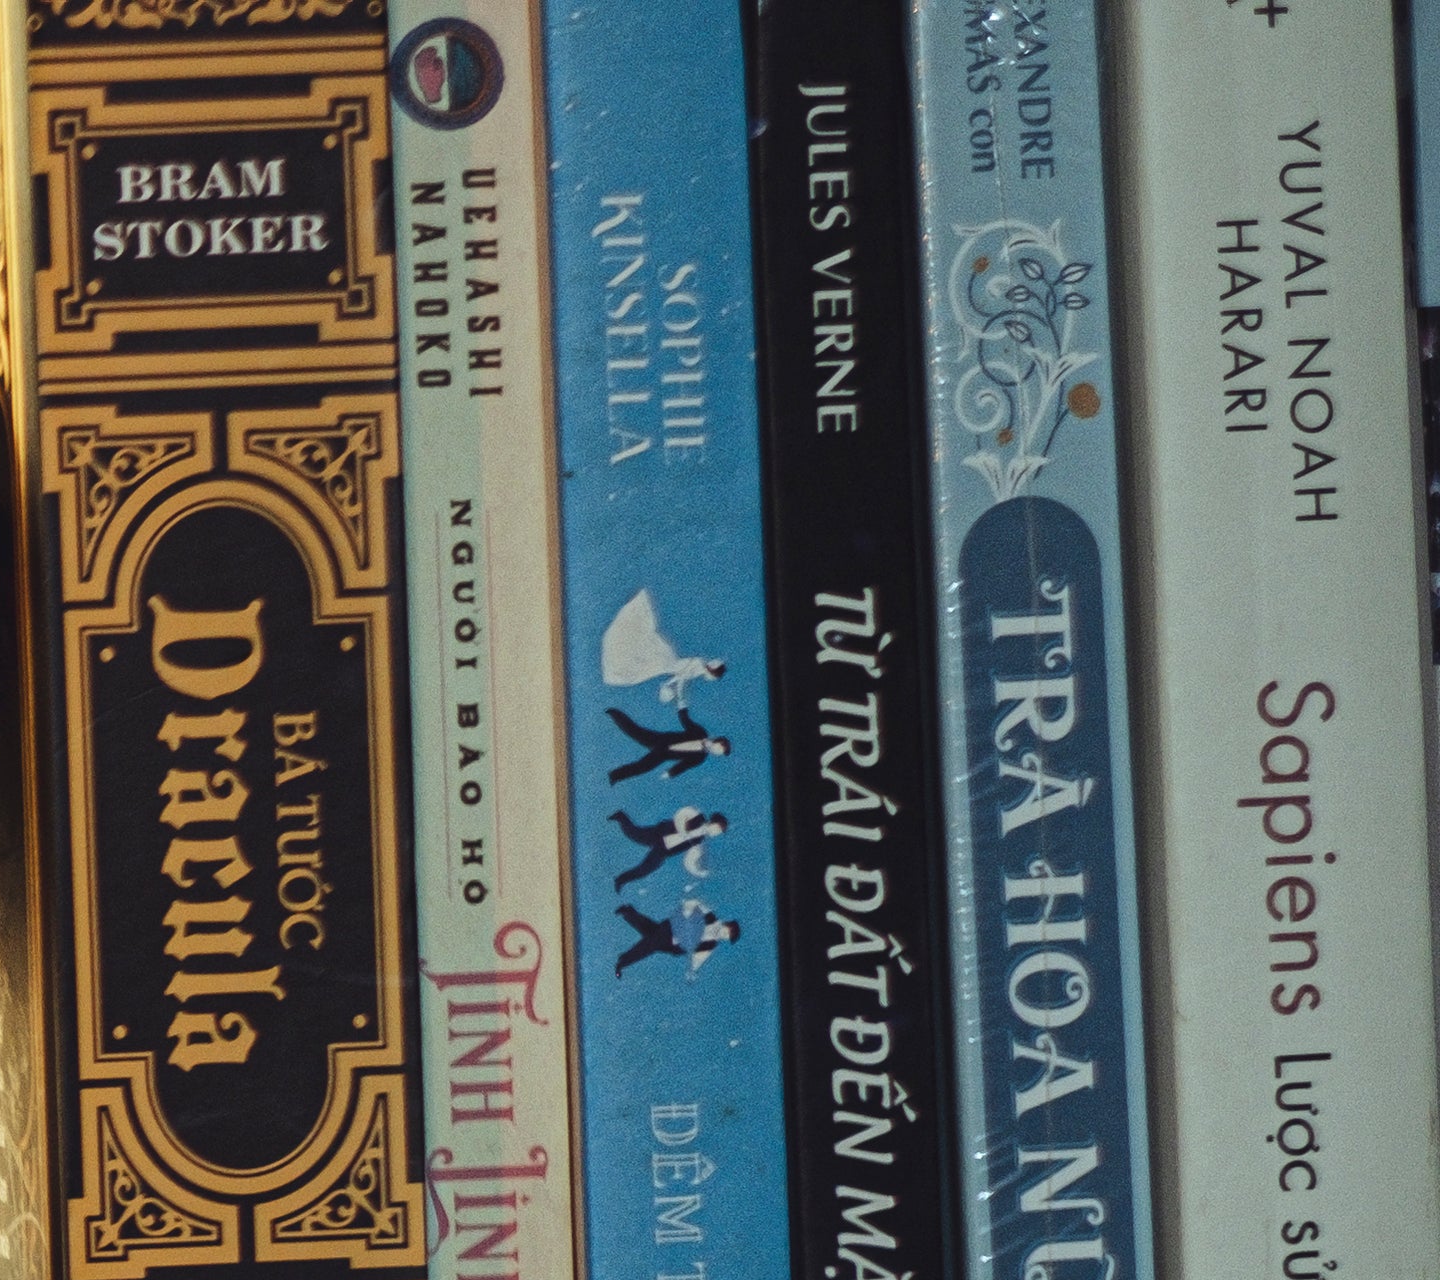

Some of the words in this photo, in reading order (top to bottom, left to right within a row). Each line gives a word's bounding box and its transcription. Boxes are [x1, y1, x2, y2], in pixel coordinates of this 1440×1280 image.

[115, 158, 286, 207] BRAM
[799, 85, 850, 232] JULES
[970, 106, 998, 173] con
[1275, 120, 1328, 310] YUVAL
[93, 213, 329, 262] STOKER
[411, 181, 451, 390] NAHOKO
[463, 167, 504, 398] UEHASHI
[591, 193, 652, 466] KINSELLA
[1216, 219, 1268, 434] HARARI
[660, 263, 706, 467] SOPHIE
[811, 249, 857, 434] VERNE
[1287, 337, 1340, 523] NOAH
[814, 588, 896, 678] TỪ
[990, 578, 1096, 836] TRÀ
[148, 595, 286, 1072] Dracula
[274, 712, 328, 785] BÁ
[819, 694, 896, 843] TRÁI
[275, 794, 334, 950] TƯỚC
[825, 863, 914, 1007] ĐẤT
[1236, 680, 1337, 1016] Sapiens
[1005, 861, 1096, 1118] HOA
[829, 1016, 918, 1165] ĐẾN
[1264, 1054, 1332, 1191] Lược
